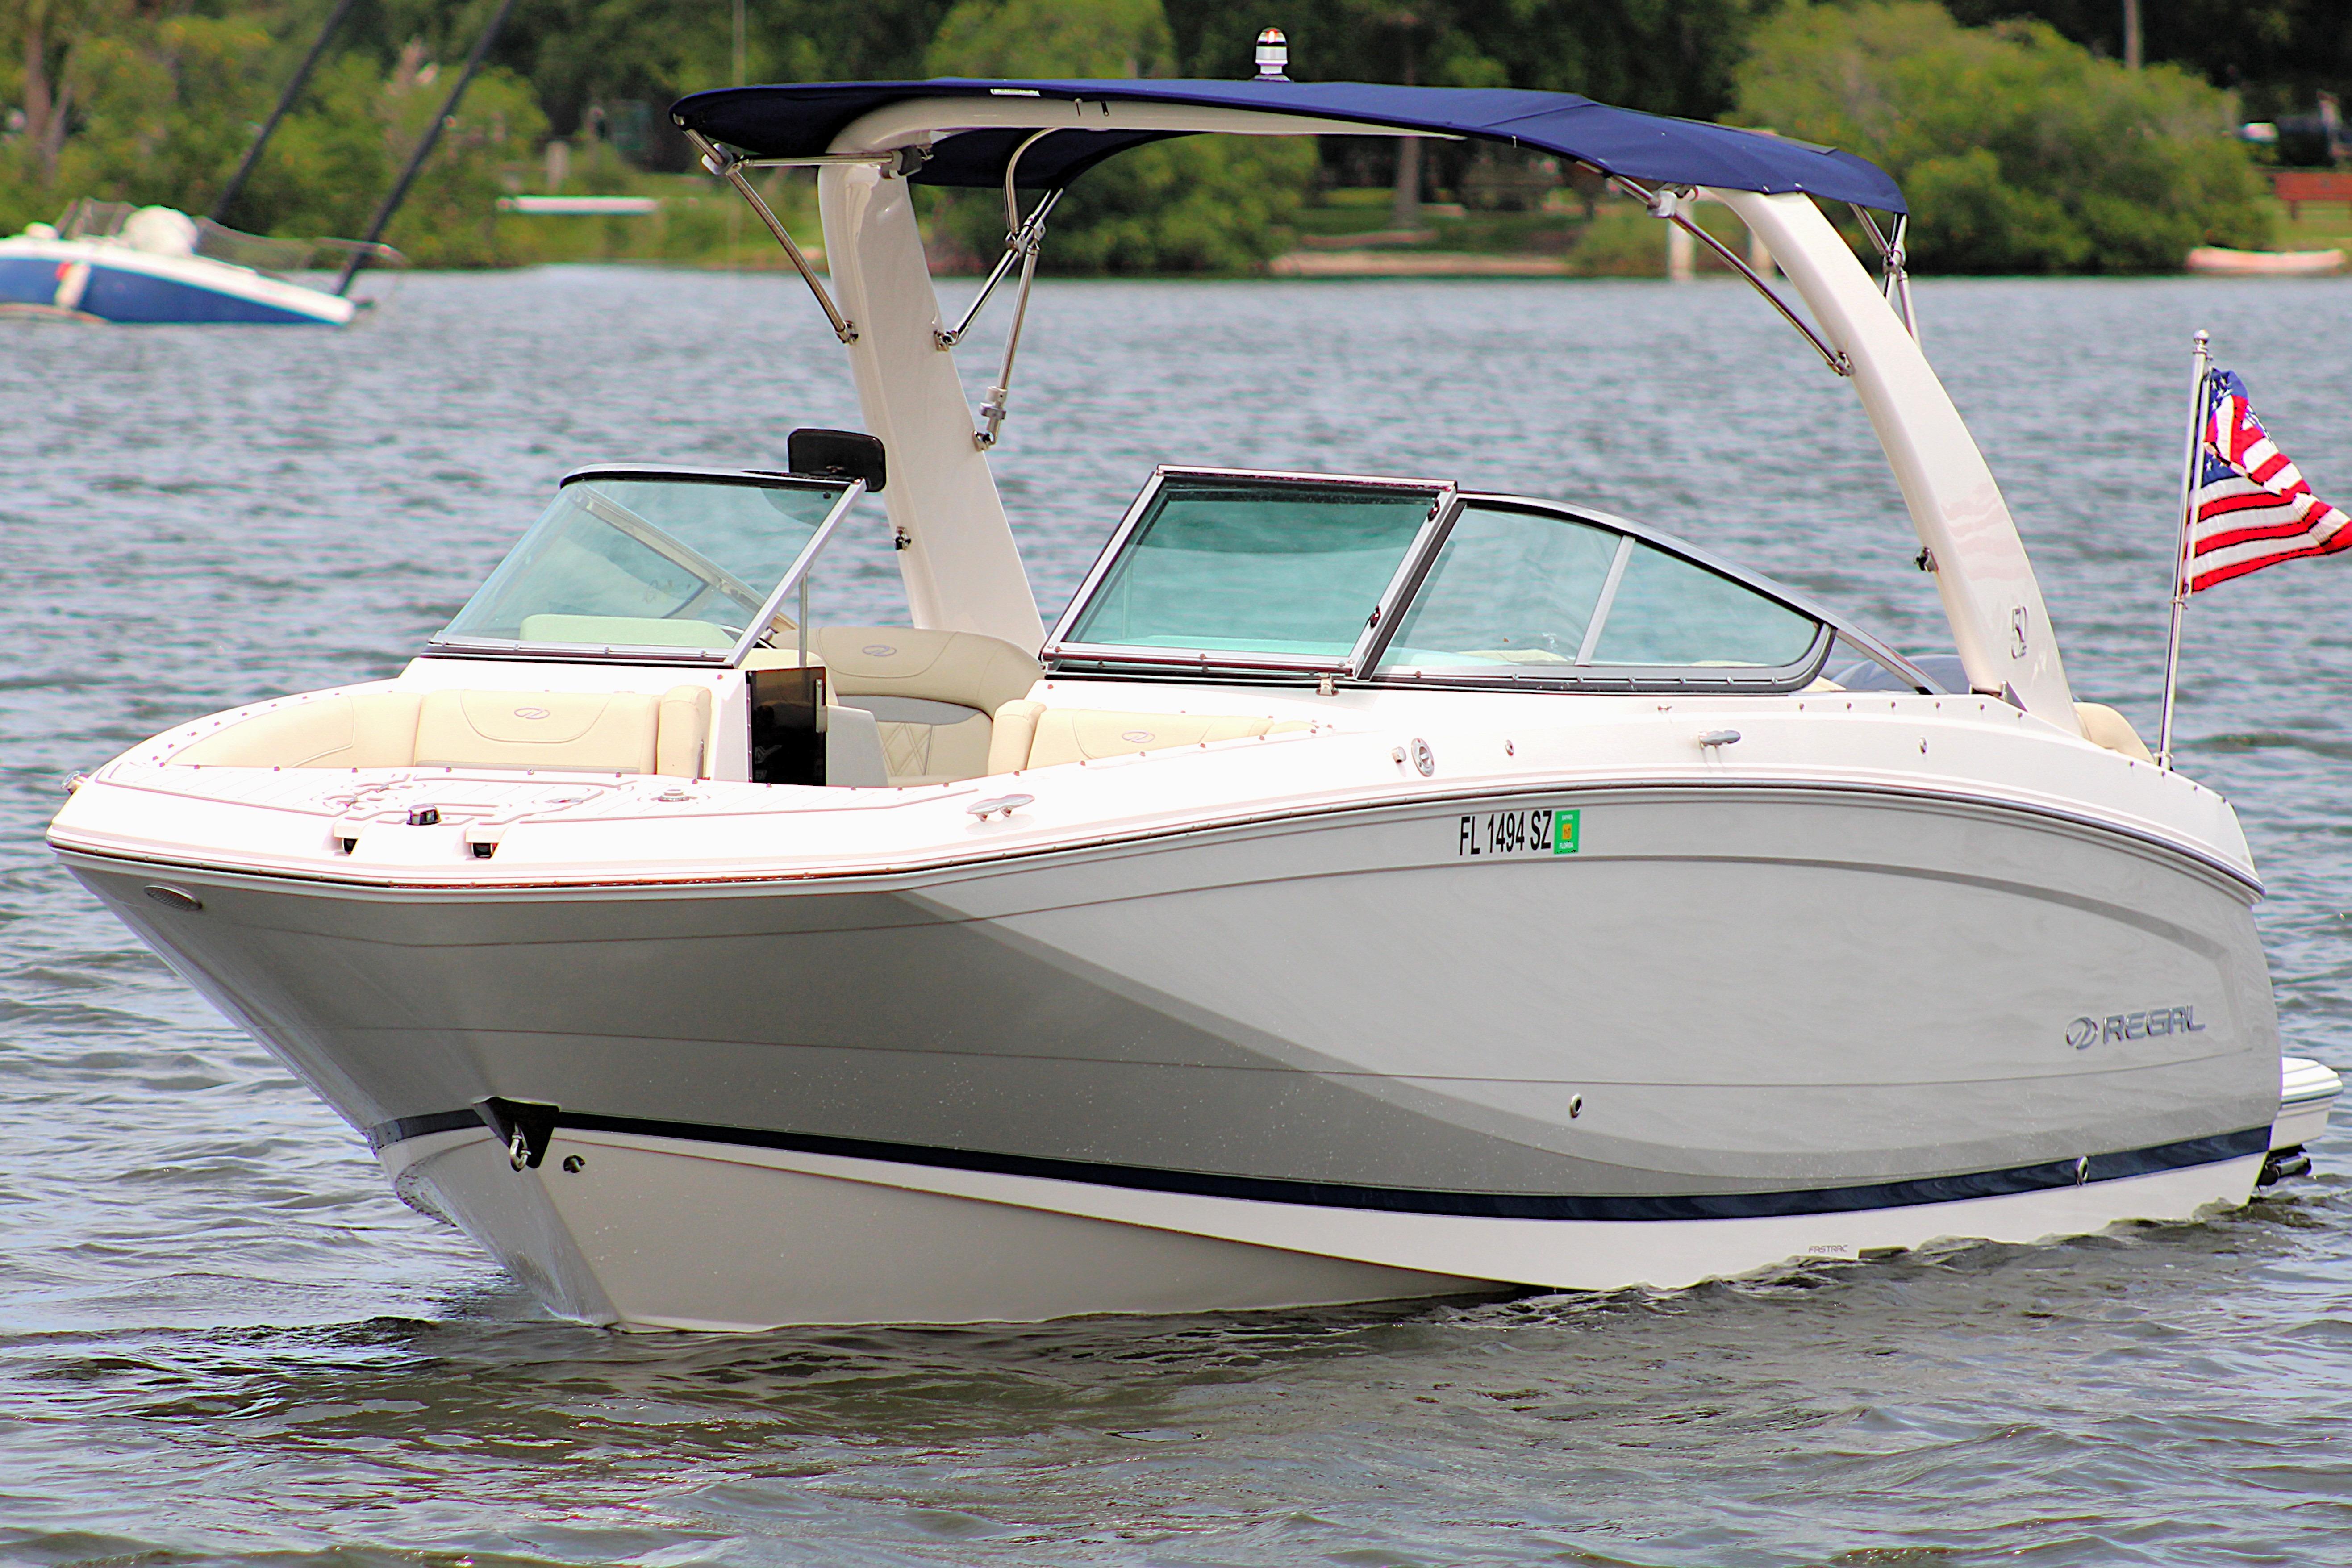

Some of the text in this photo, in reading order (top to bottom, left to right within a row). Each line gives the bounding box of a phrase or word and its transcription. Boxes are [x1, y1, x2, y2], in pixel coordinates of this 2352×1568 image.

[1459, 809, 1552, 856] FL 1494 SZ
[2103, 1005, 2206, 1044] REGAL
[1808, 1244, 1848, 1253] FASTRAC
